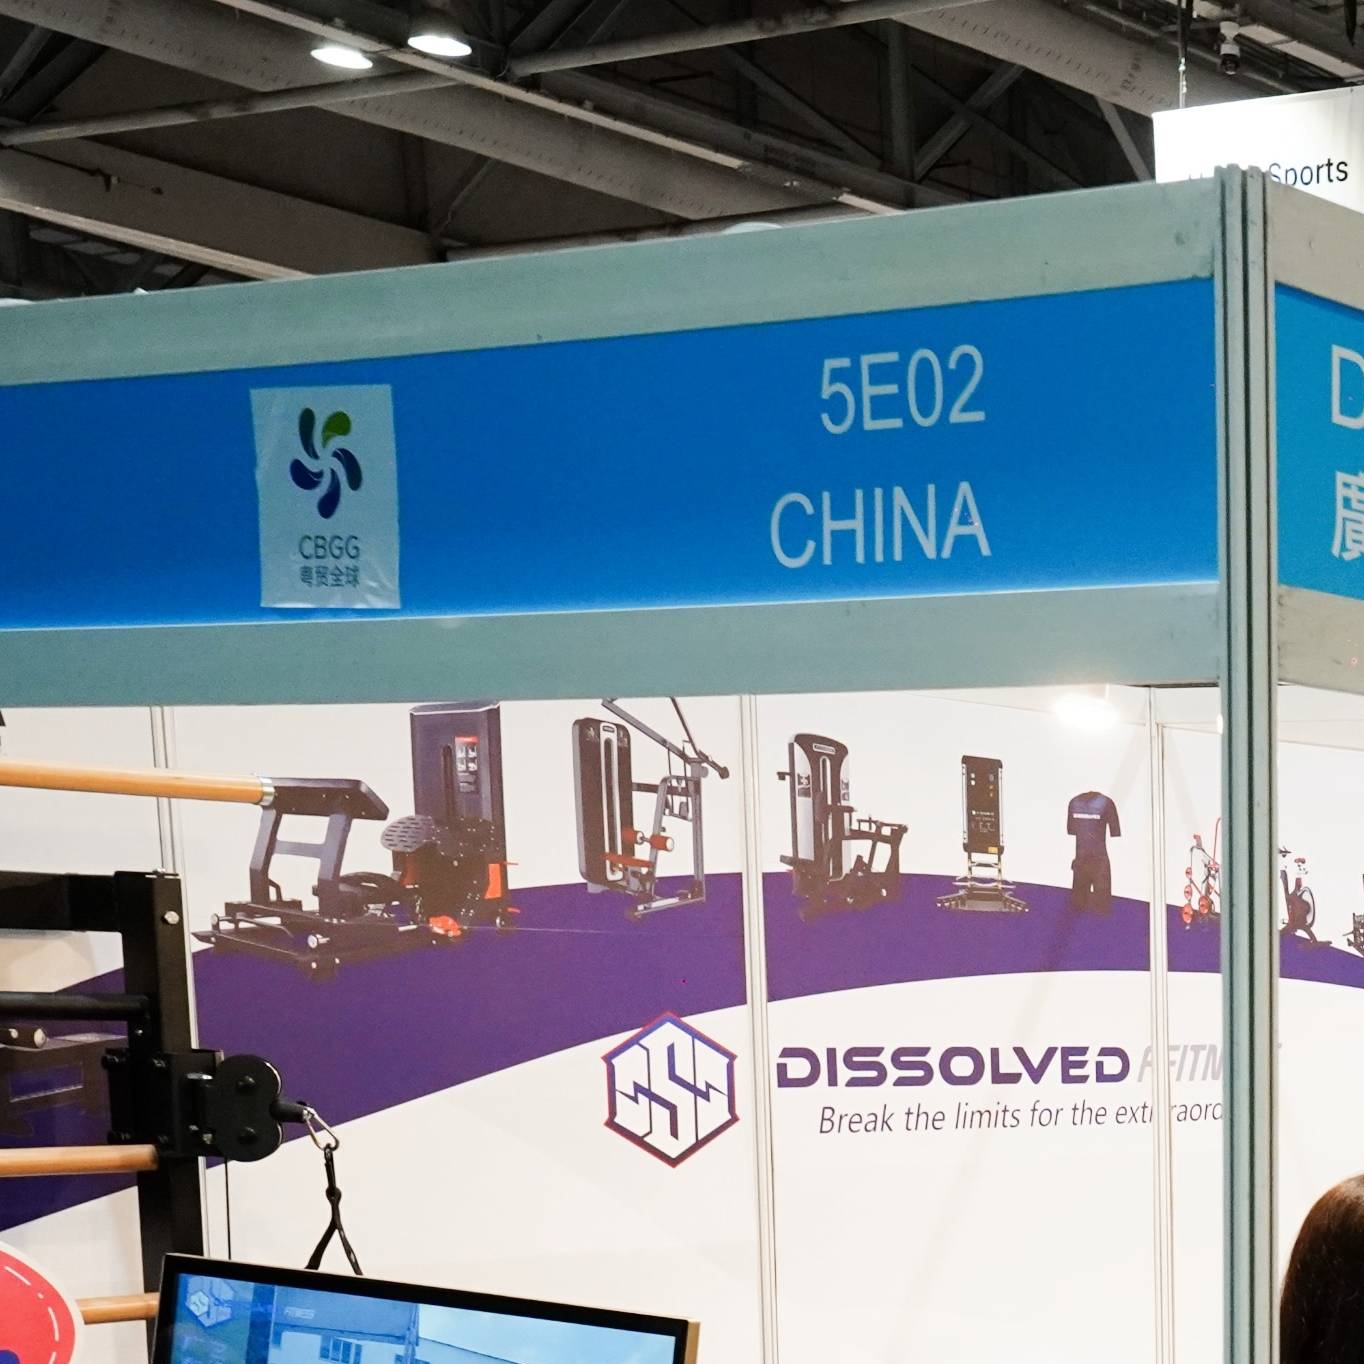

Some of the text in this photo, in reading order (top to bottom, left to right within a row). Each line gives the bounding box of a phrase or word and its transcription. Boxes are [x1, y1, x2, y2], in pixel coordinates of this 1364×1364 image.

[818, 344, 988, 435] 5E02
[770, 481, 991, 569] CHINA
[298, 534, 361, 560] CBGG
[776, 1045, 1130, 1088] DISSOLVED
[819, 1103, 894, 1135] Break
[904, 1103, 947, 1134] the
[954, 1101, 1020, 1131] limits
[1029, 1100, 1065, 1129] for
[1071, 1099, 1109, 1127] the
